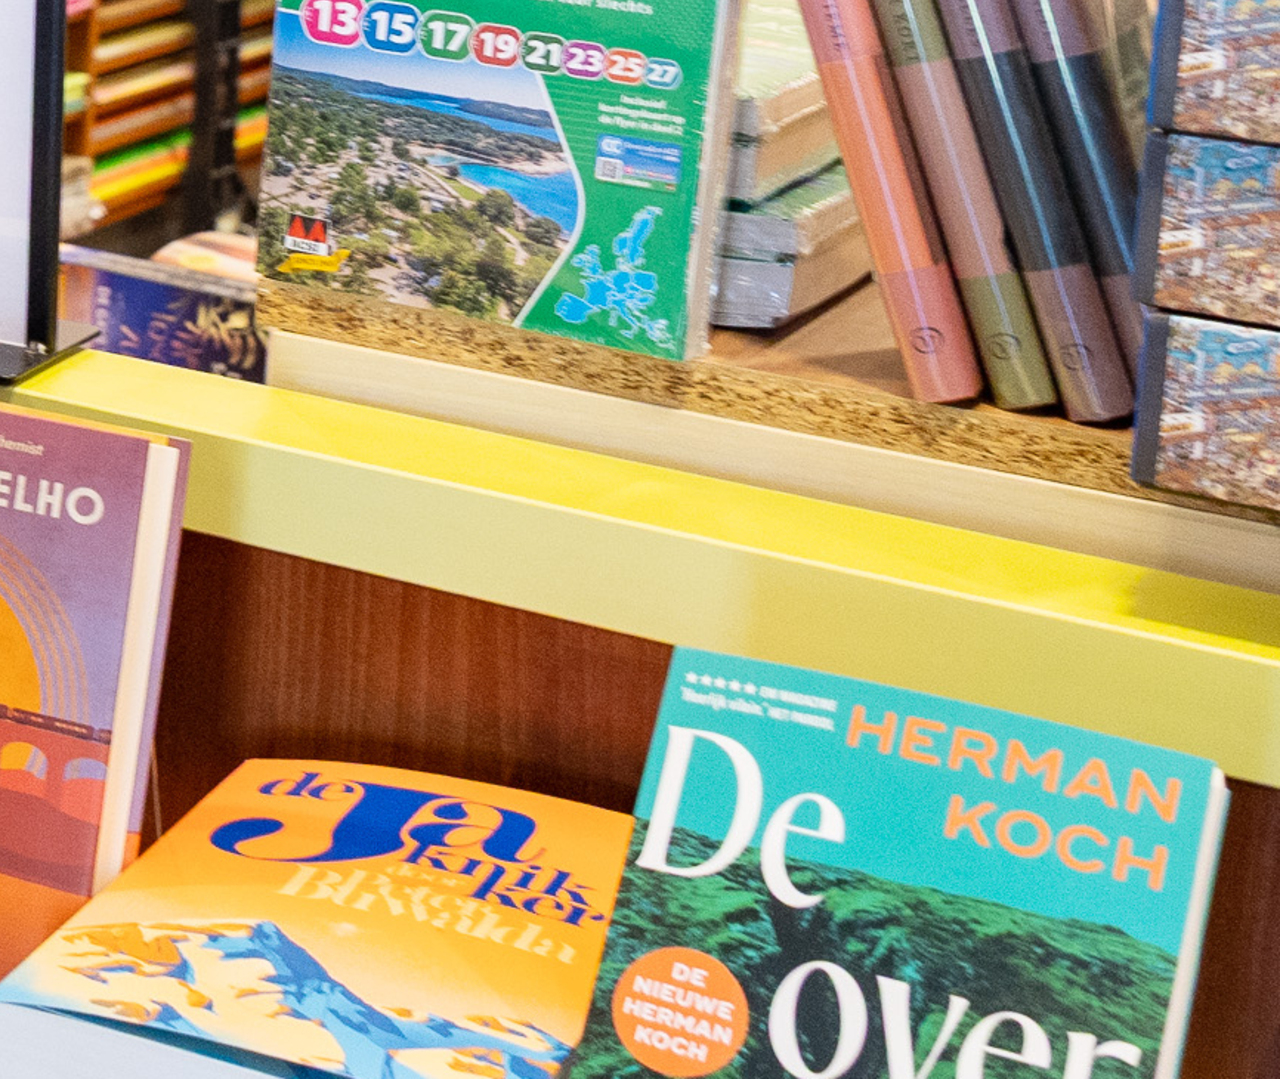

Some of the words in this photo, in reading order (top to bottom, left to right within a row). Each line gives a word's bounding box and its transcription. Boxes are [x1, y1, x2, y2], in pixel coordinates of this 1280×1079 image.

[370, 10, 415, 45] 15
[427, 20, 473, 51] 17
[479, 31, 519, 59] 19
[525, 39, 561, 66] 21
[566, 47, 604, 72] 23
[606, 55, 644, 79] 25
[258, 772, 355, 801] de
[845, 705, 1182, 823] HERMAN
[635, 724, 846, 909] De
[943, 794, 1170, 892] KOCH
[633, 976, 735, 1019] NIEUWE
[670, 961, 709, 989] DE
[622, 997, 733, 1047] HERMAN
[634, 1025, 709, 1063] KOCH
